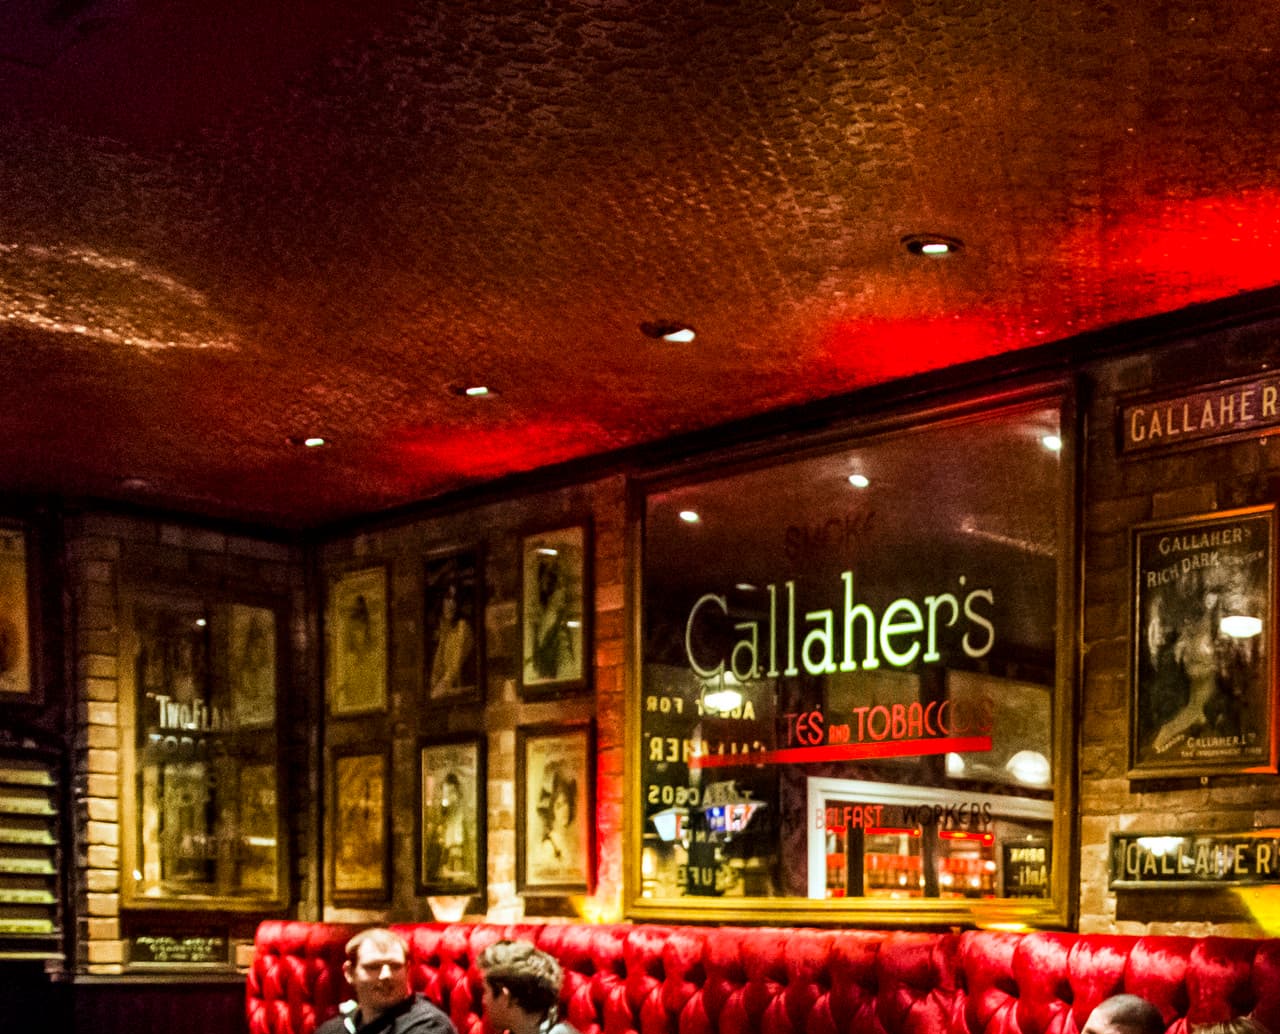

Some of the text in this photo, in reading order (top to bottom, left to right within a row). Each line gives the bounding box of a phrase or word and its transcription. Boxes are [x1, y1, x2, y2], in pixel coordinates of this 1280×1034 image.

[1182, 551, 1219, 573] DARK
[828, 724, 851, 745] AND
[902, 801, 993, 826] WORKERS
